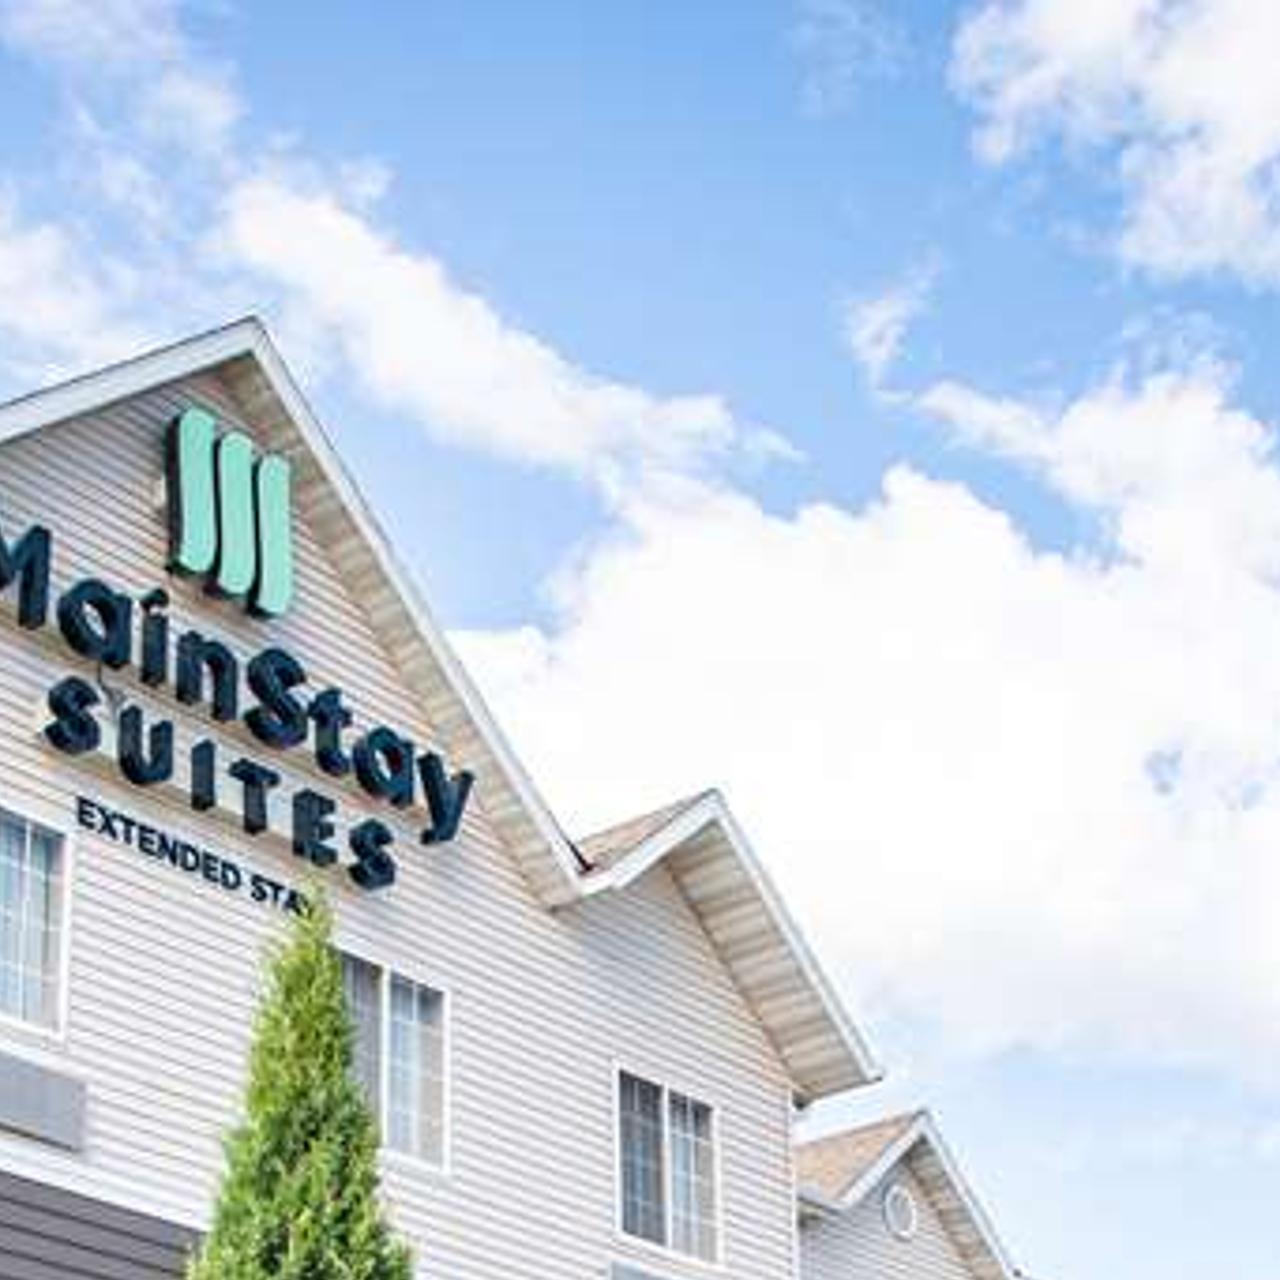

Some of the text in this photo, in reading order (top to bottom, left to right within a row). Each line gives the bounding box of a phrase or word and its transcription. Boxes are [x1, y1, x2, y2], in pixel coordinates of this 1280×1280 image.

[43, 676, 397, 890] SUITES
[76, 796, 316, 920] EXTENDED STA
